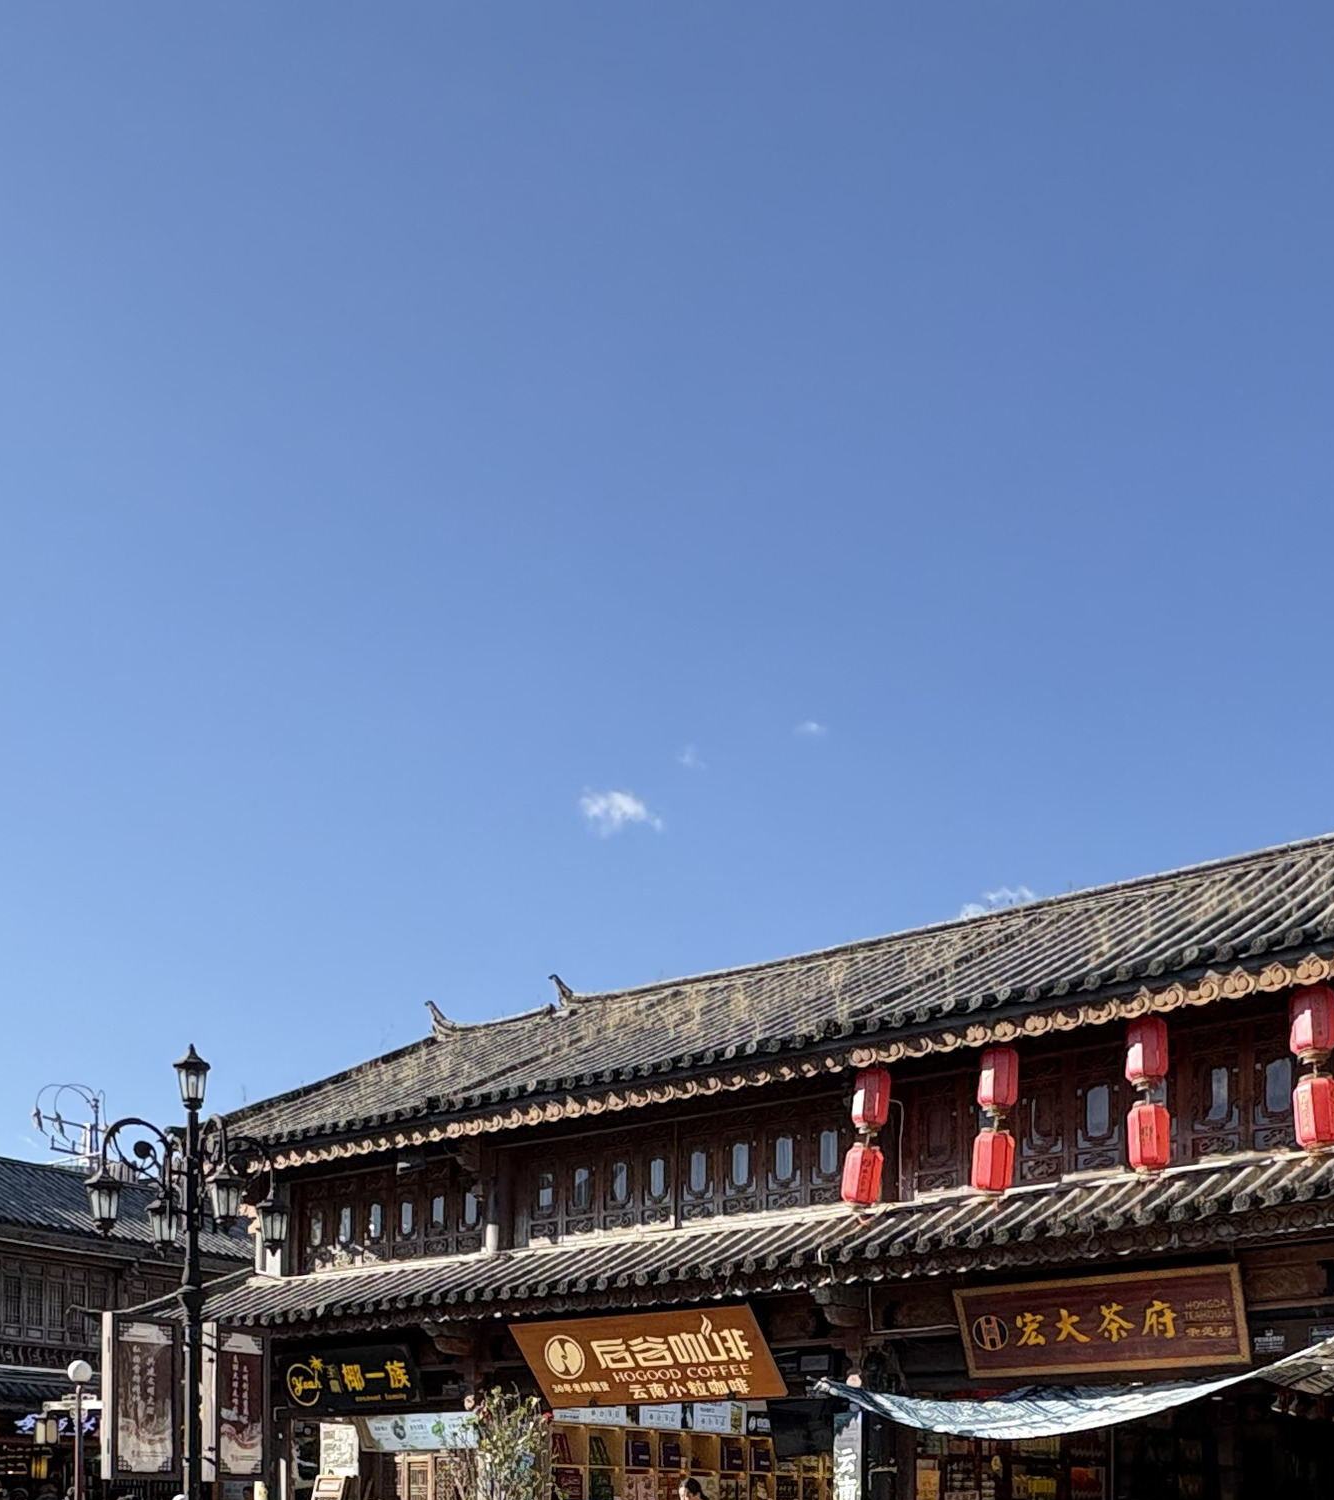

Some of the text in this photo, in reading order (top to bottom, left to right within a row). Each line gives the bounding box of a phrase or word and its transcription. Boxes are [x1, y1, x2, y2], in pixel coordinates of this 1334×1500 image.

[1015, 1300, 1177, 1347] 宏大茶府
[590, 1324, 754, 1370] 后谷咖啡
[612, 1364, 753, 1384] HOGOOD COFFEE
[628, 1378, 750, 1400] 云南小粒咖啡
